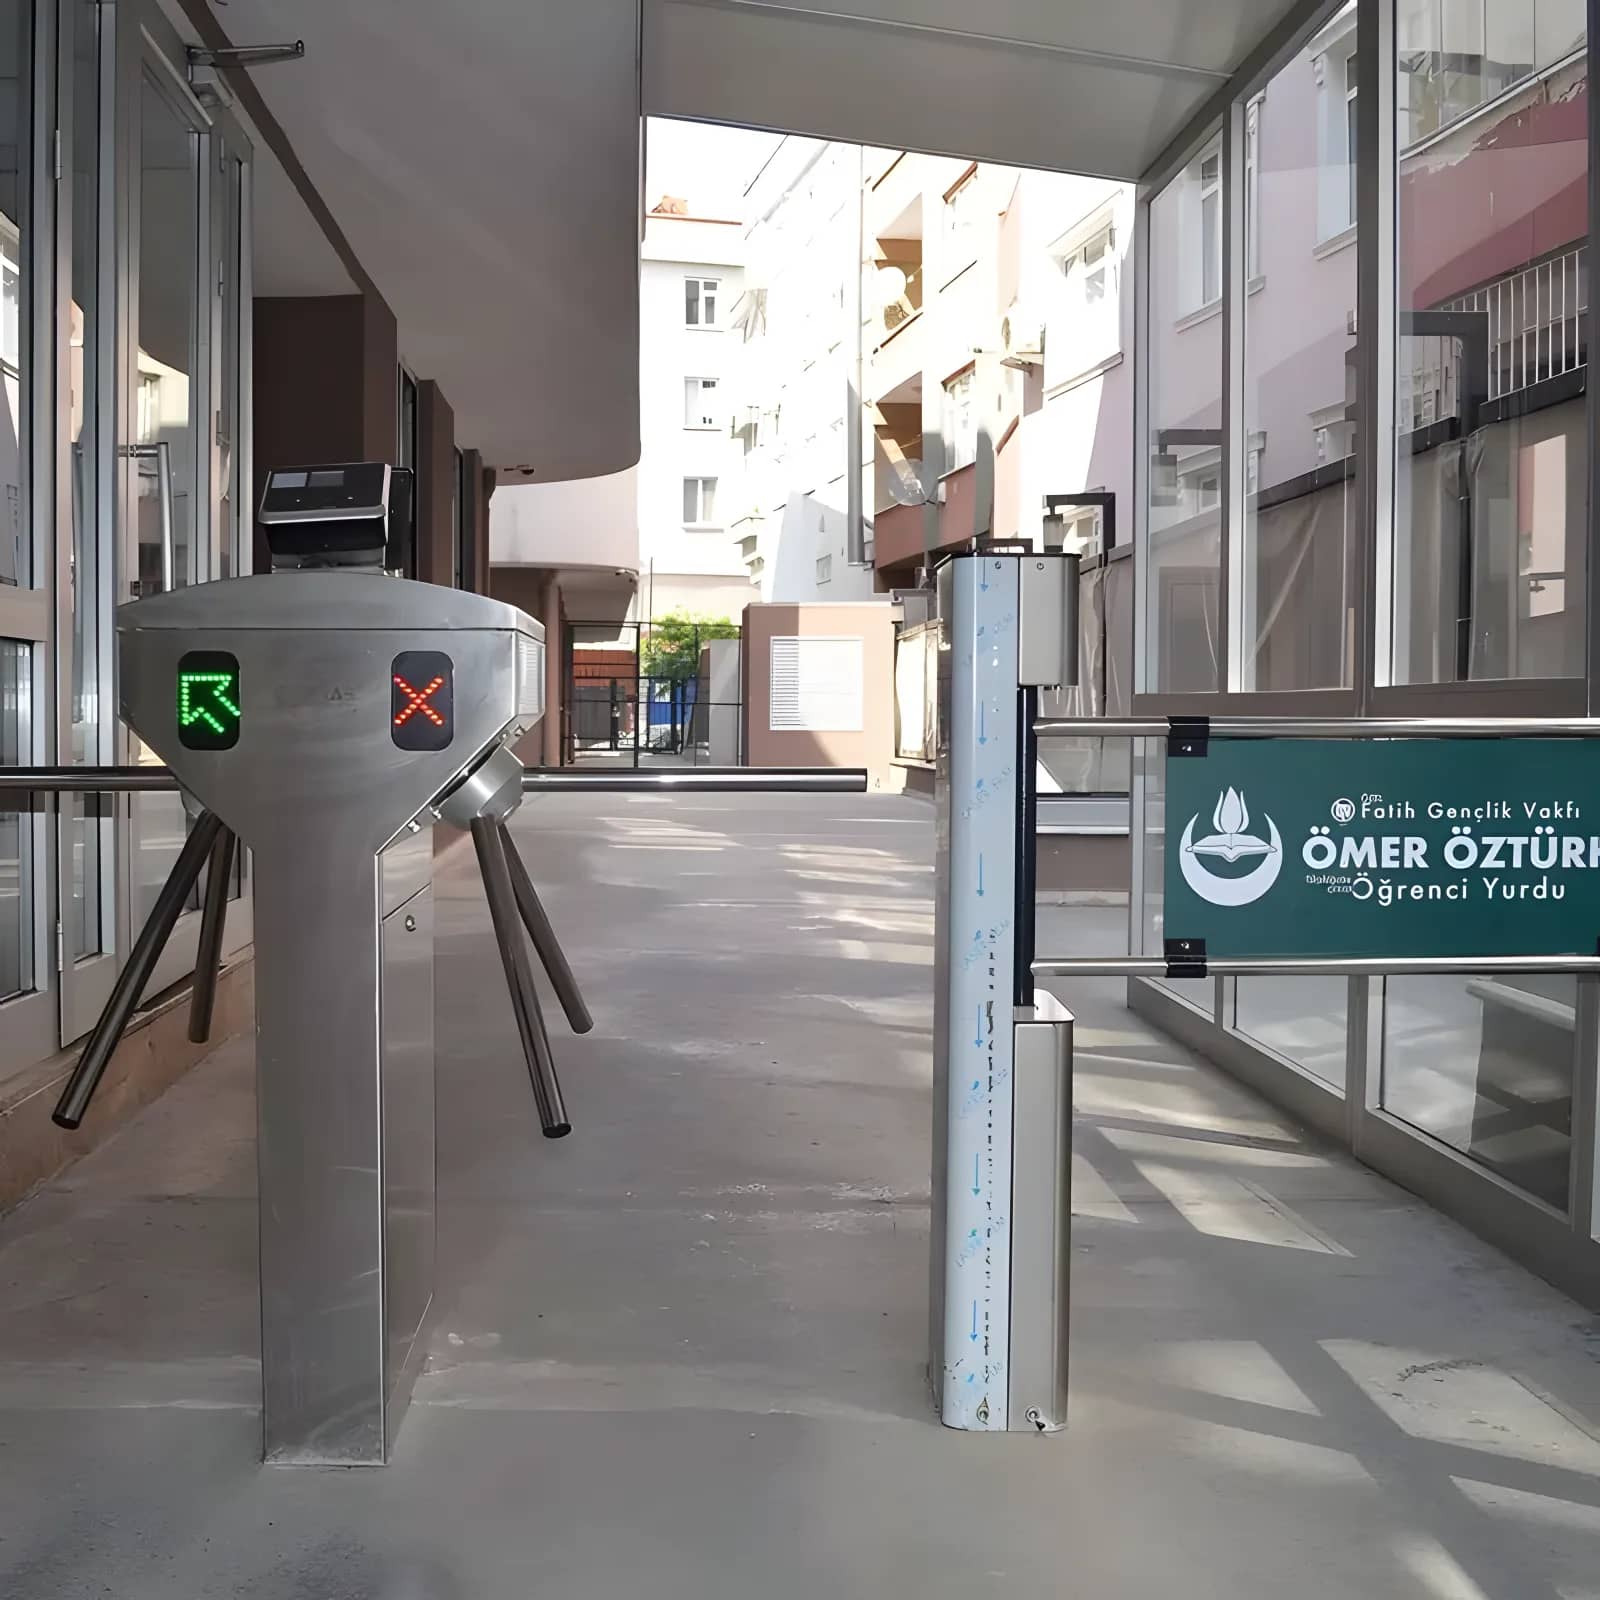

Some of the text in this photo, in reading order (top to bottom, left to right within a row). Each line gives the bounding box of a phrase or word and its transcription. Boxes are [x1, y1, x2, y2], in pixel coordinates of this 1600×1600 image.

[1361, 801, 1580, 823] Fatih Gençlik Vakfı
[1302, 825, 1429, 869] ÖMER
[1352, 872, 1467, 906] Öğrenci
[1482, 875, 1565, 900] Yurdu
